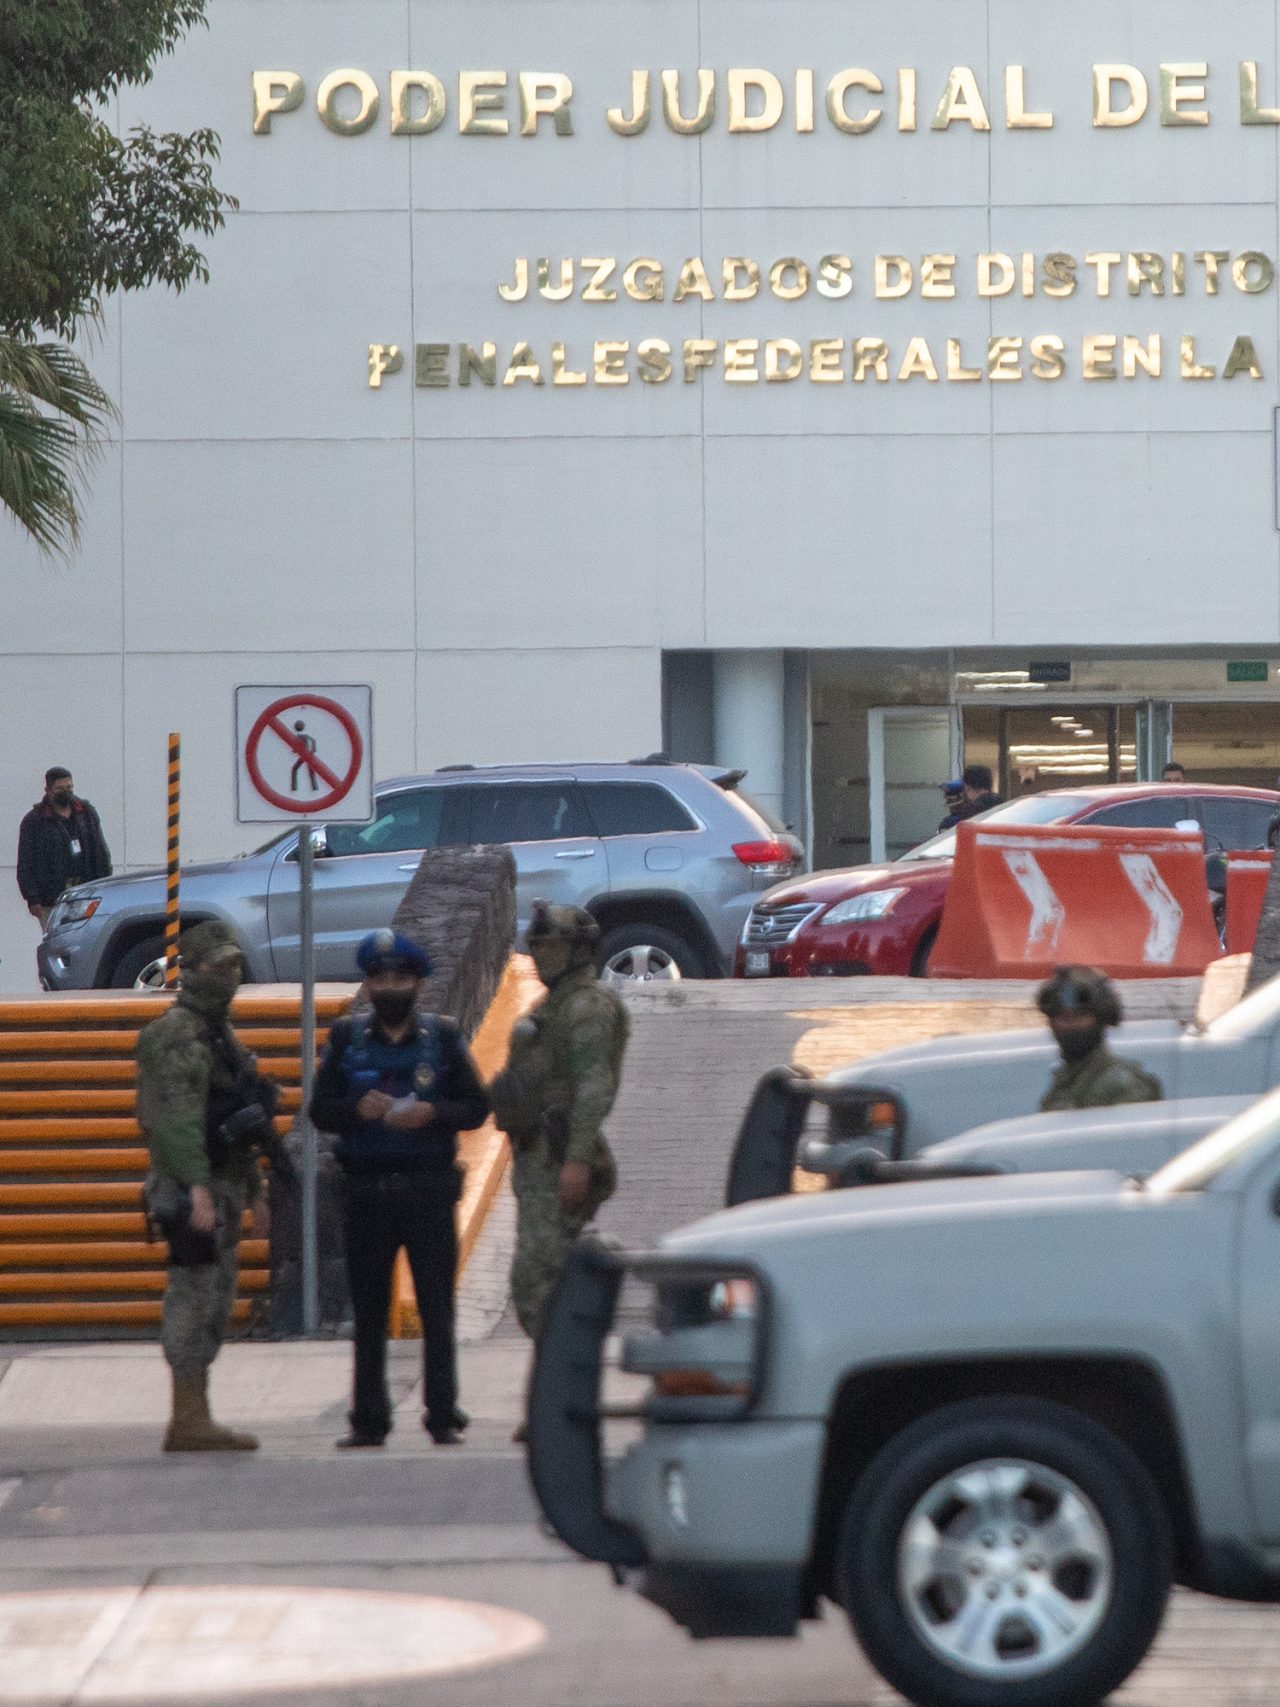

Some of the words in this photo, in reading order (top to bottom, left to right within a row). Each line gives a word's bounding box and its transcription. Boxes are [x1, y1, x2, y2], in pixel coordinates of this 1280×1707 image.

[250, 68, 575, 137] PODER
[605, 65, 1055, 137] JUDICIAL
[1090, 62, 1211, 130] DE
[497, 254, 854, 303] JUZGADOS
[872, 252, 957, 299] DE
[975, 250, 1275, 299] DISTRITO
[367, 339, 675, 389] PENALES
[681, 335, 1066, 384] FEDERALES
[1080, 332, 1162, 381] EN
[1179, 334, 1263, 380] LA
